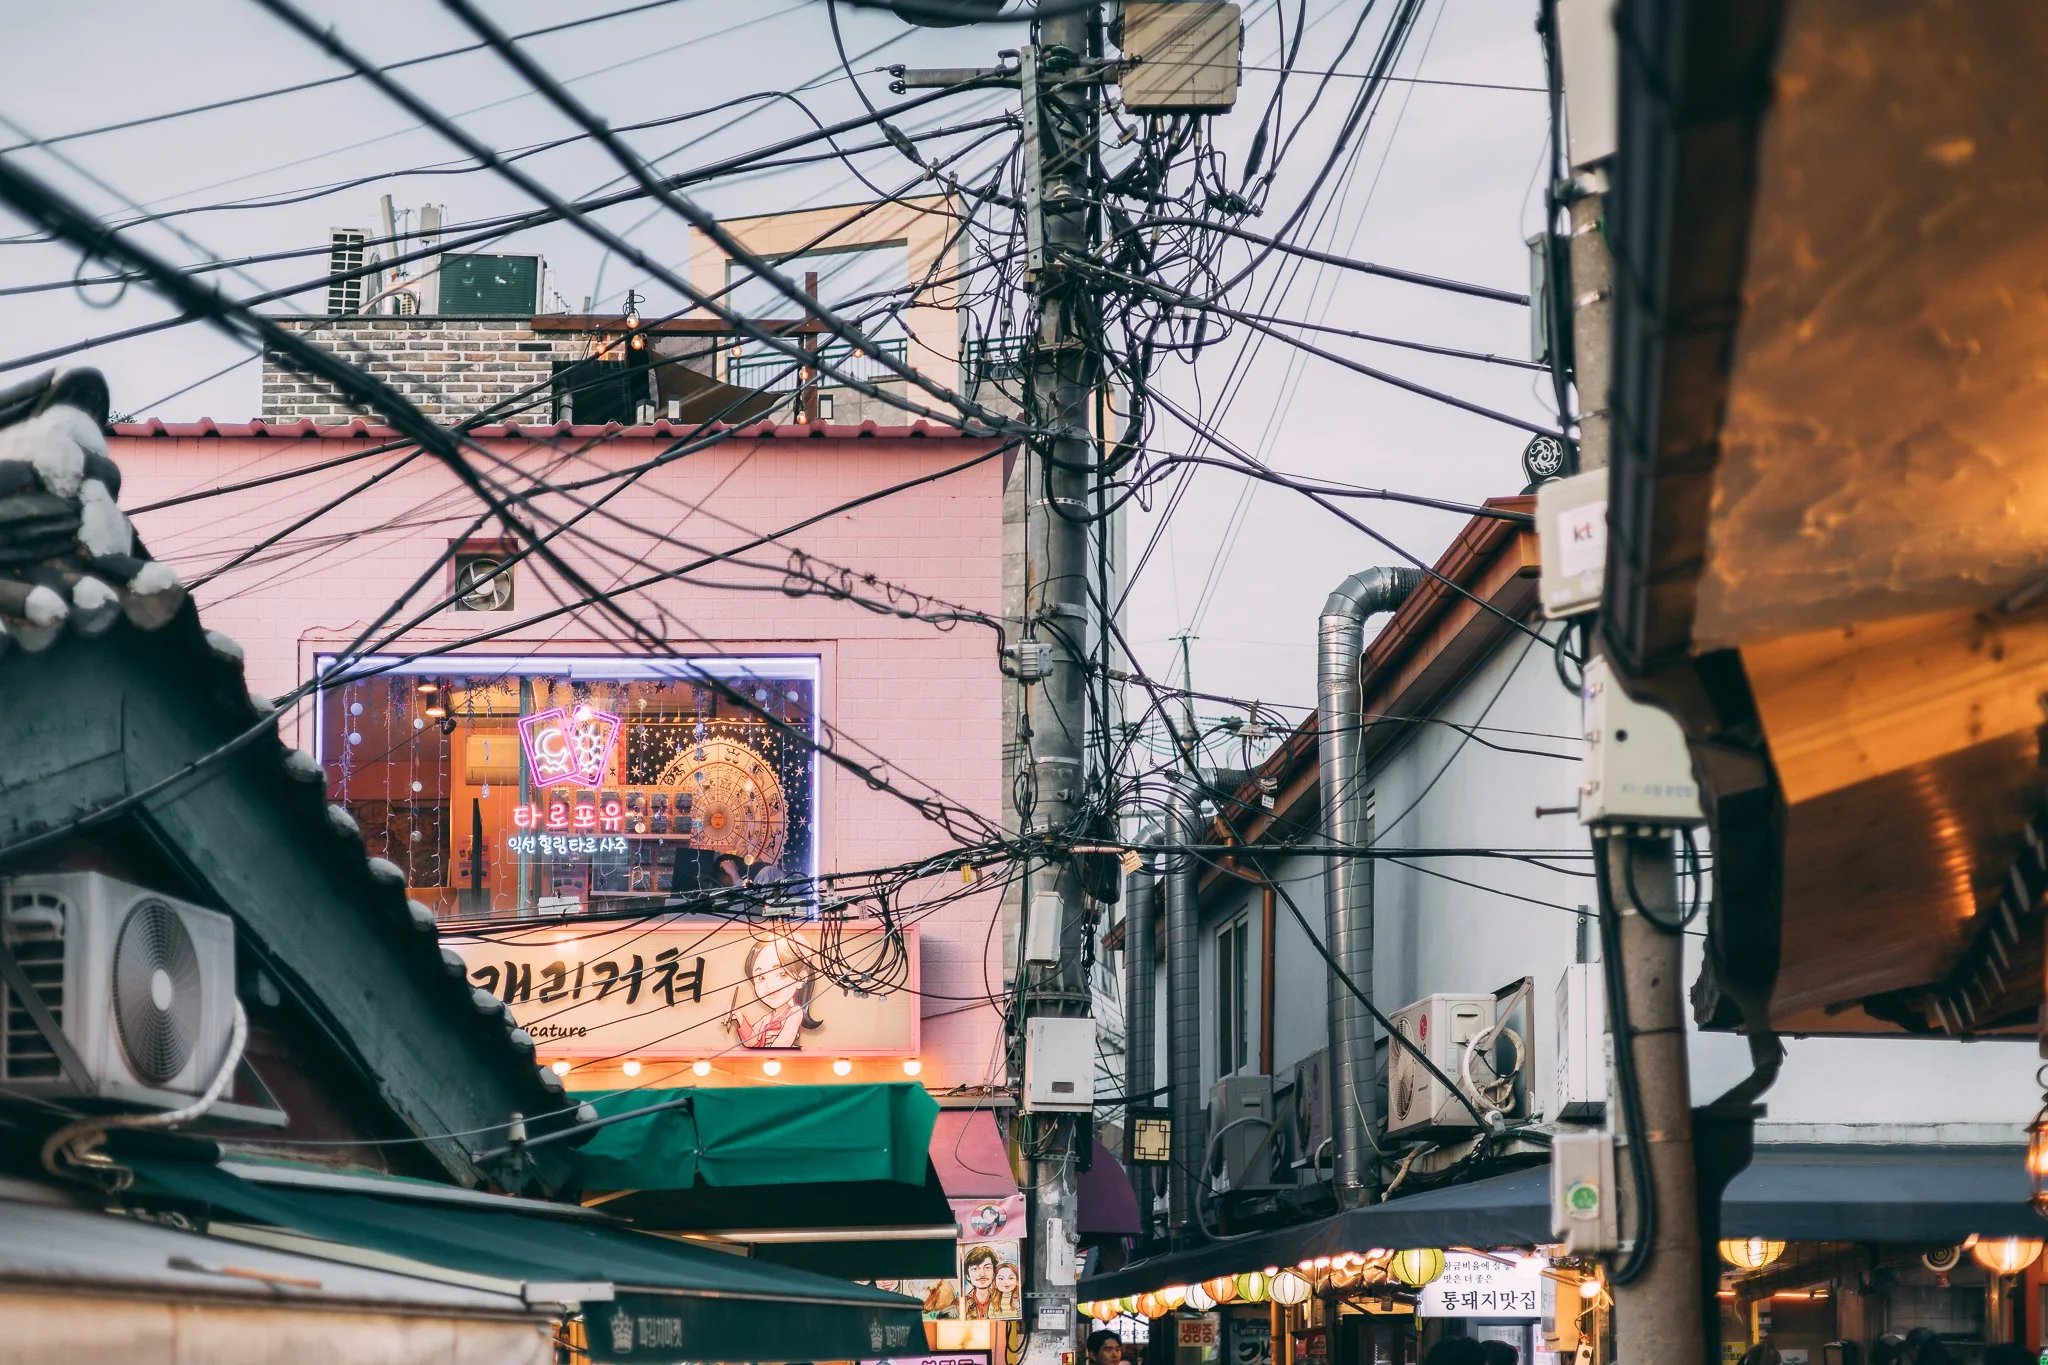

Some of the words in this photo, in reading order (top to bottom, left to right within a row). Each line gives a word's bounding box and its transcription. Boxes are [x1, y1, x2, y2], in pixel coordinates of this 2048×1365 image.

[1573, 521, 1592, 542] kt
[512, 802, 623, 831] 타로포유
[507, 836, 535, 854] 익선
[599, 836, 628, 854] 사주
[471, 947, 706, 1007] 캐리커쳐
[1464, 1274, 1473, 1284] 더
[1441, 1290, 1536, 1311] 통돼지맛집
[1182, 1323, 1212, 1344] 냉방중
